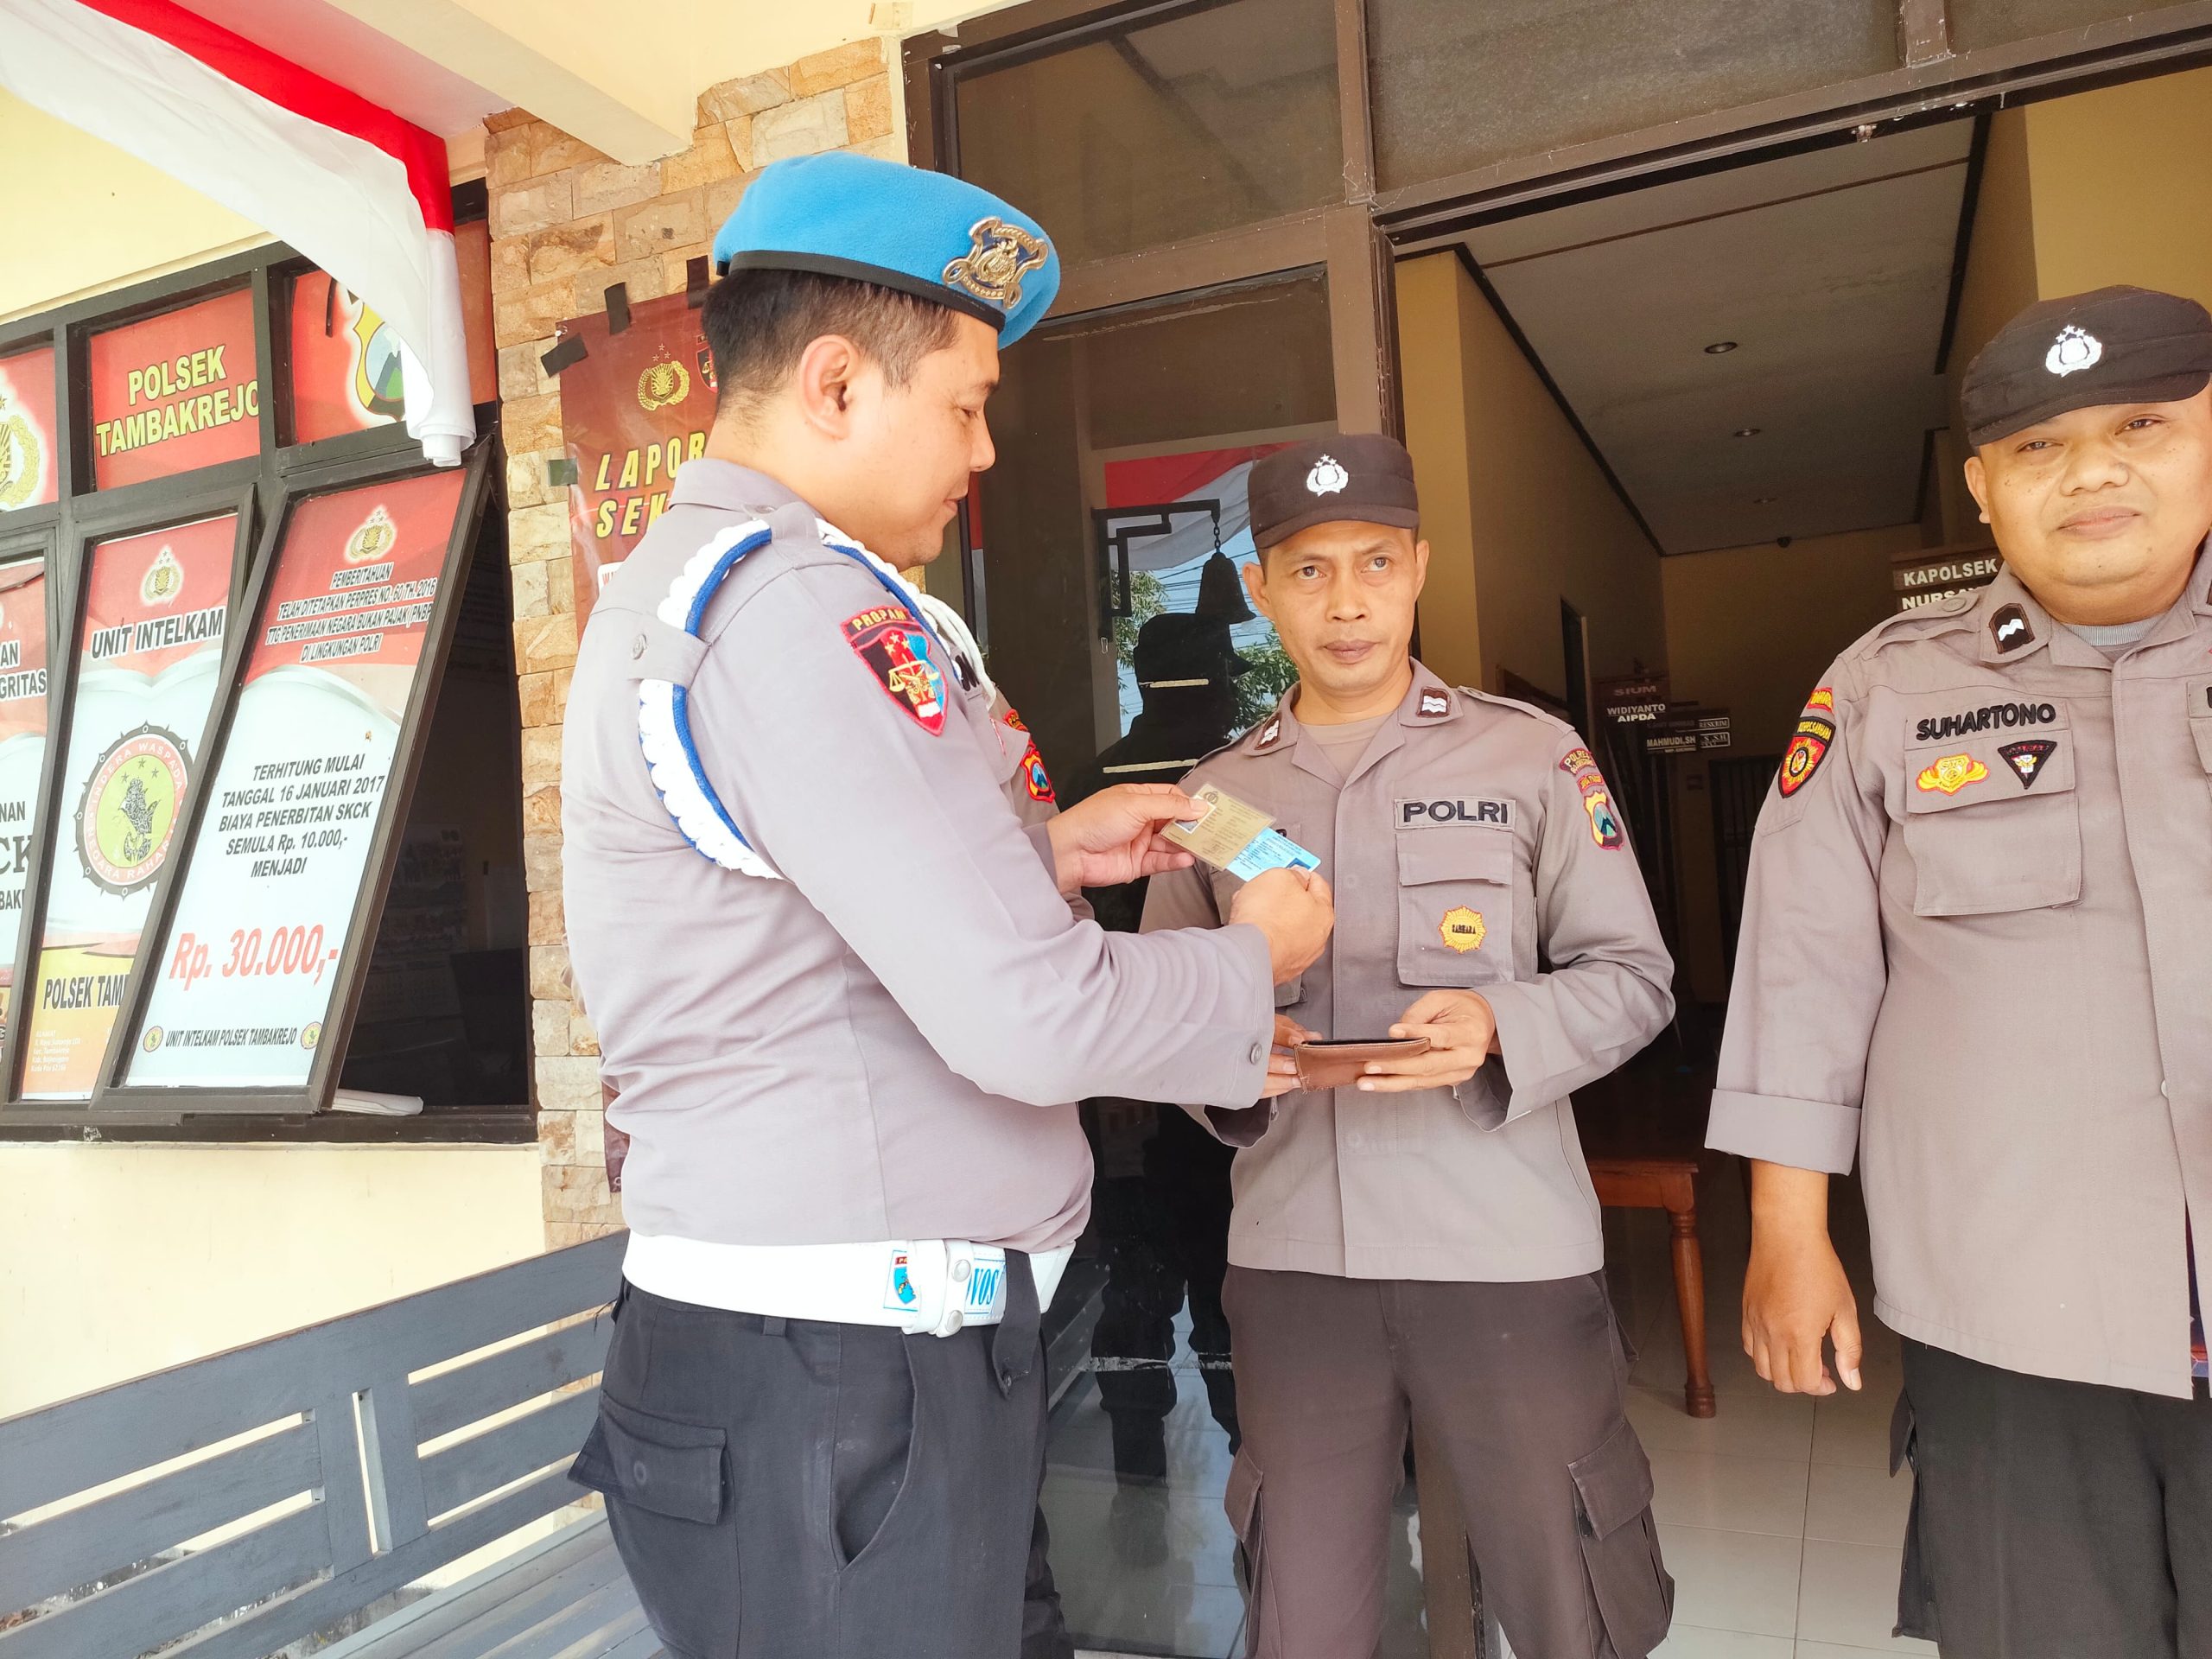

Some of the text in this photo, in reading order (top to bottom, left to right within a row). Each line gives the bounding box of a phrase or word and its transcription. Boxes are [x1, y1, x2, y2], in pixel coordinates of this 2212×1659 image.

[128, 345, 226, 406] POLSEK
[96, 380, 259, 457] TAMBAKREJO
[331, 563, 393, 588] PEMBERITAHUAN
[1904, 558, 1999, 587] KAPOLSEK
[278, 600, 302, 620] TELAH
[301, 594, 345, 616] DITETAPKAN
[346, 588, 378, 608] PERPRES
[393, 584, 404, 601] 60
[416, 578, 436, 598] 2016
[92, 608, 225, 659] UNIT INTELKAM
[266, 626, 281, 644] TTG
[281, 620, 326, 641] PENERIMAAN
[326, 614, 357, 634] NEGARA
[356, 610, 384, 630] BUKAN
[384, 607, 409, 625] PAJAK
[852, 607, 907, 631] PROPAM
[301, 633, 382, 662] DI LINGKUNGAN POLRI
[1607, 703, 1666, 715] WIDIYANTO
[1617, 713, 1656, 723] AIPDA
[1916, 702, 2056, 741] SUHARTONO
[139, 742, 183, 791] WASPADA
[253, 753, 365, 781] TERHITUNG MULAI
[221, 775, 385, 809] TANGGAL 16 JANUARI 2017
[219, 801, 373, 832] BIAYA PENERBITAN SKCK
[1403, 800, 1508, 824] POLRI
[226, 829, 348, 855] SEMULA Rp. 10.000,-
[251, 856, 308, 878] MENJADI
[169, 924, 340, 991] Rp. 30.000,-
[43, 974, 130, 1010] POLSEK TAM
[165, 1027, 297, 1047] UNIT INTELKAM POLSEK TAMBAKREJO
[966, 1268, 1000, 1306] VOS
